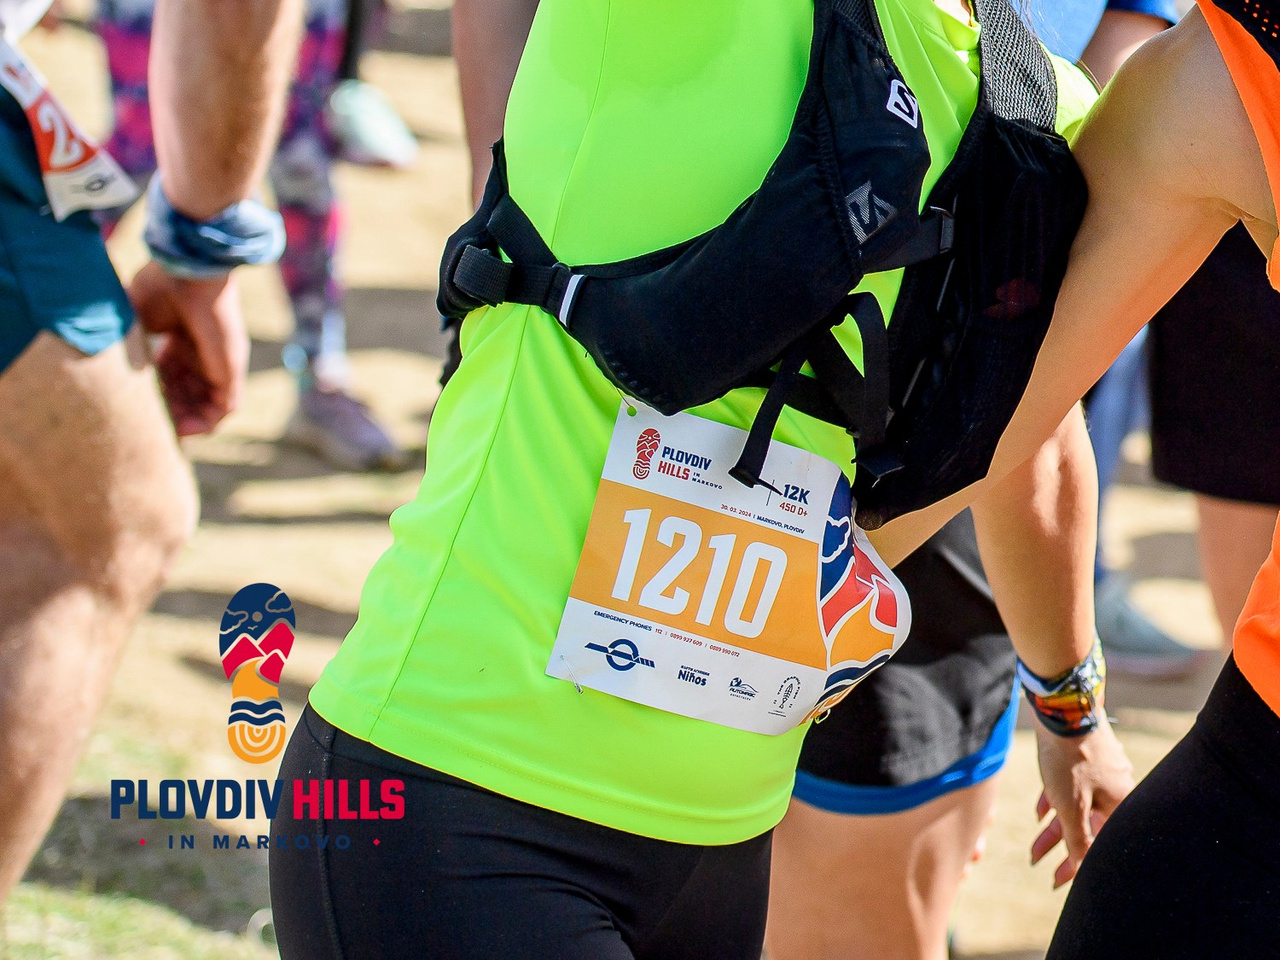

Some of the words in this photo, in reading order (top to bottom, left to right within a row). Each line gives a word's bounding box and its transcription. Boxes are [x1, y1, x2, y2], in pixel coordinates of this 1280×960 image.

[661, 445, 713, 471] PLOVDIV
[657, 461, 691, 481] HILLS
[691, 477, 723, 490] MARKOVO
[783, 483, 811, 505] 12K
[779, 501, 797, 514] 450
[611, 508, 788, 638] 1210
[593, 610, 629, 625] EMERGENCY
[629, 620, 652, 632] PHONES
